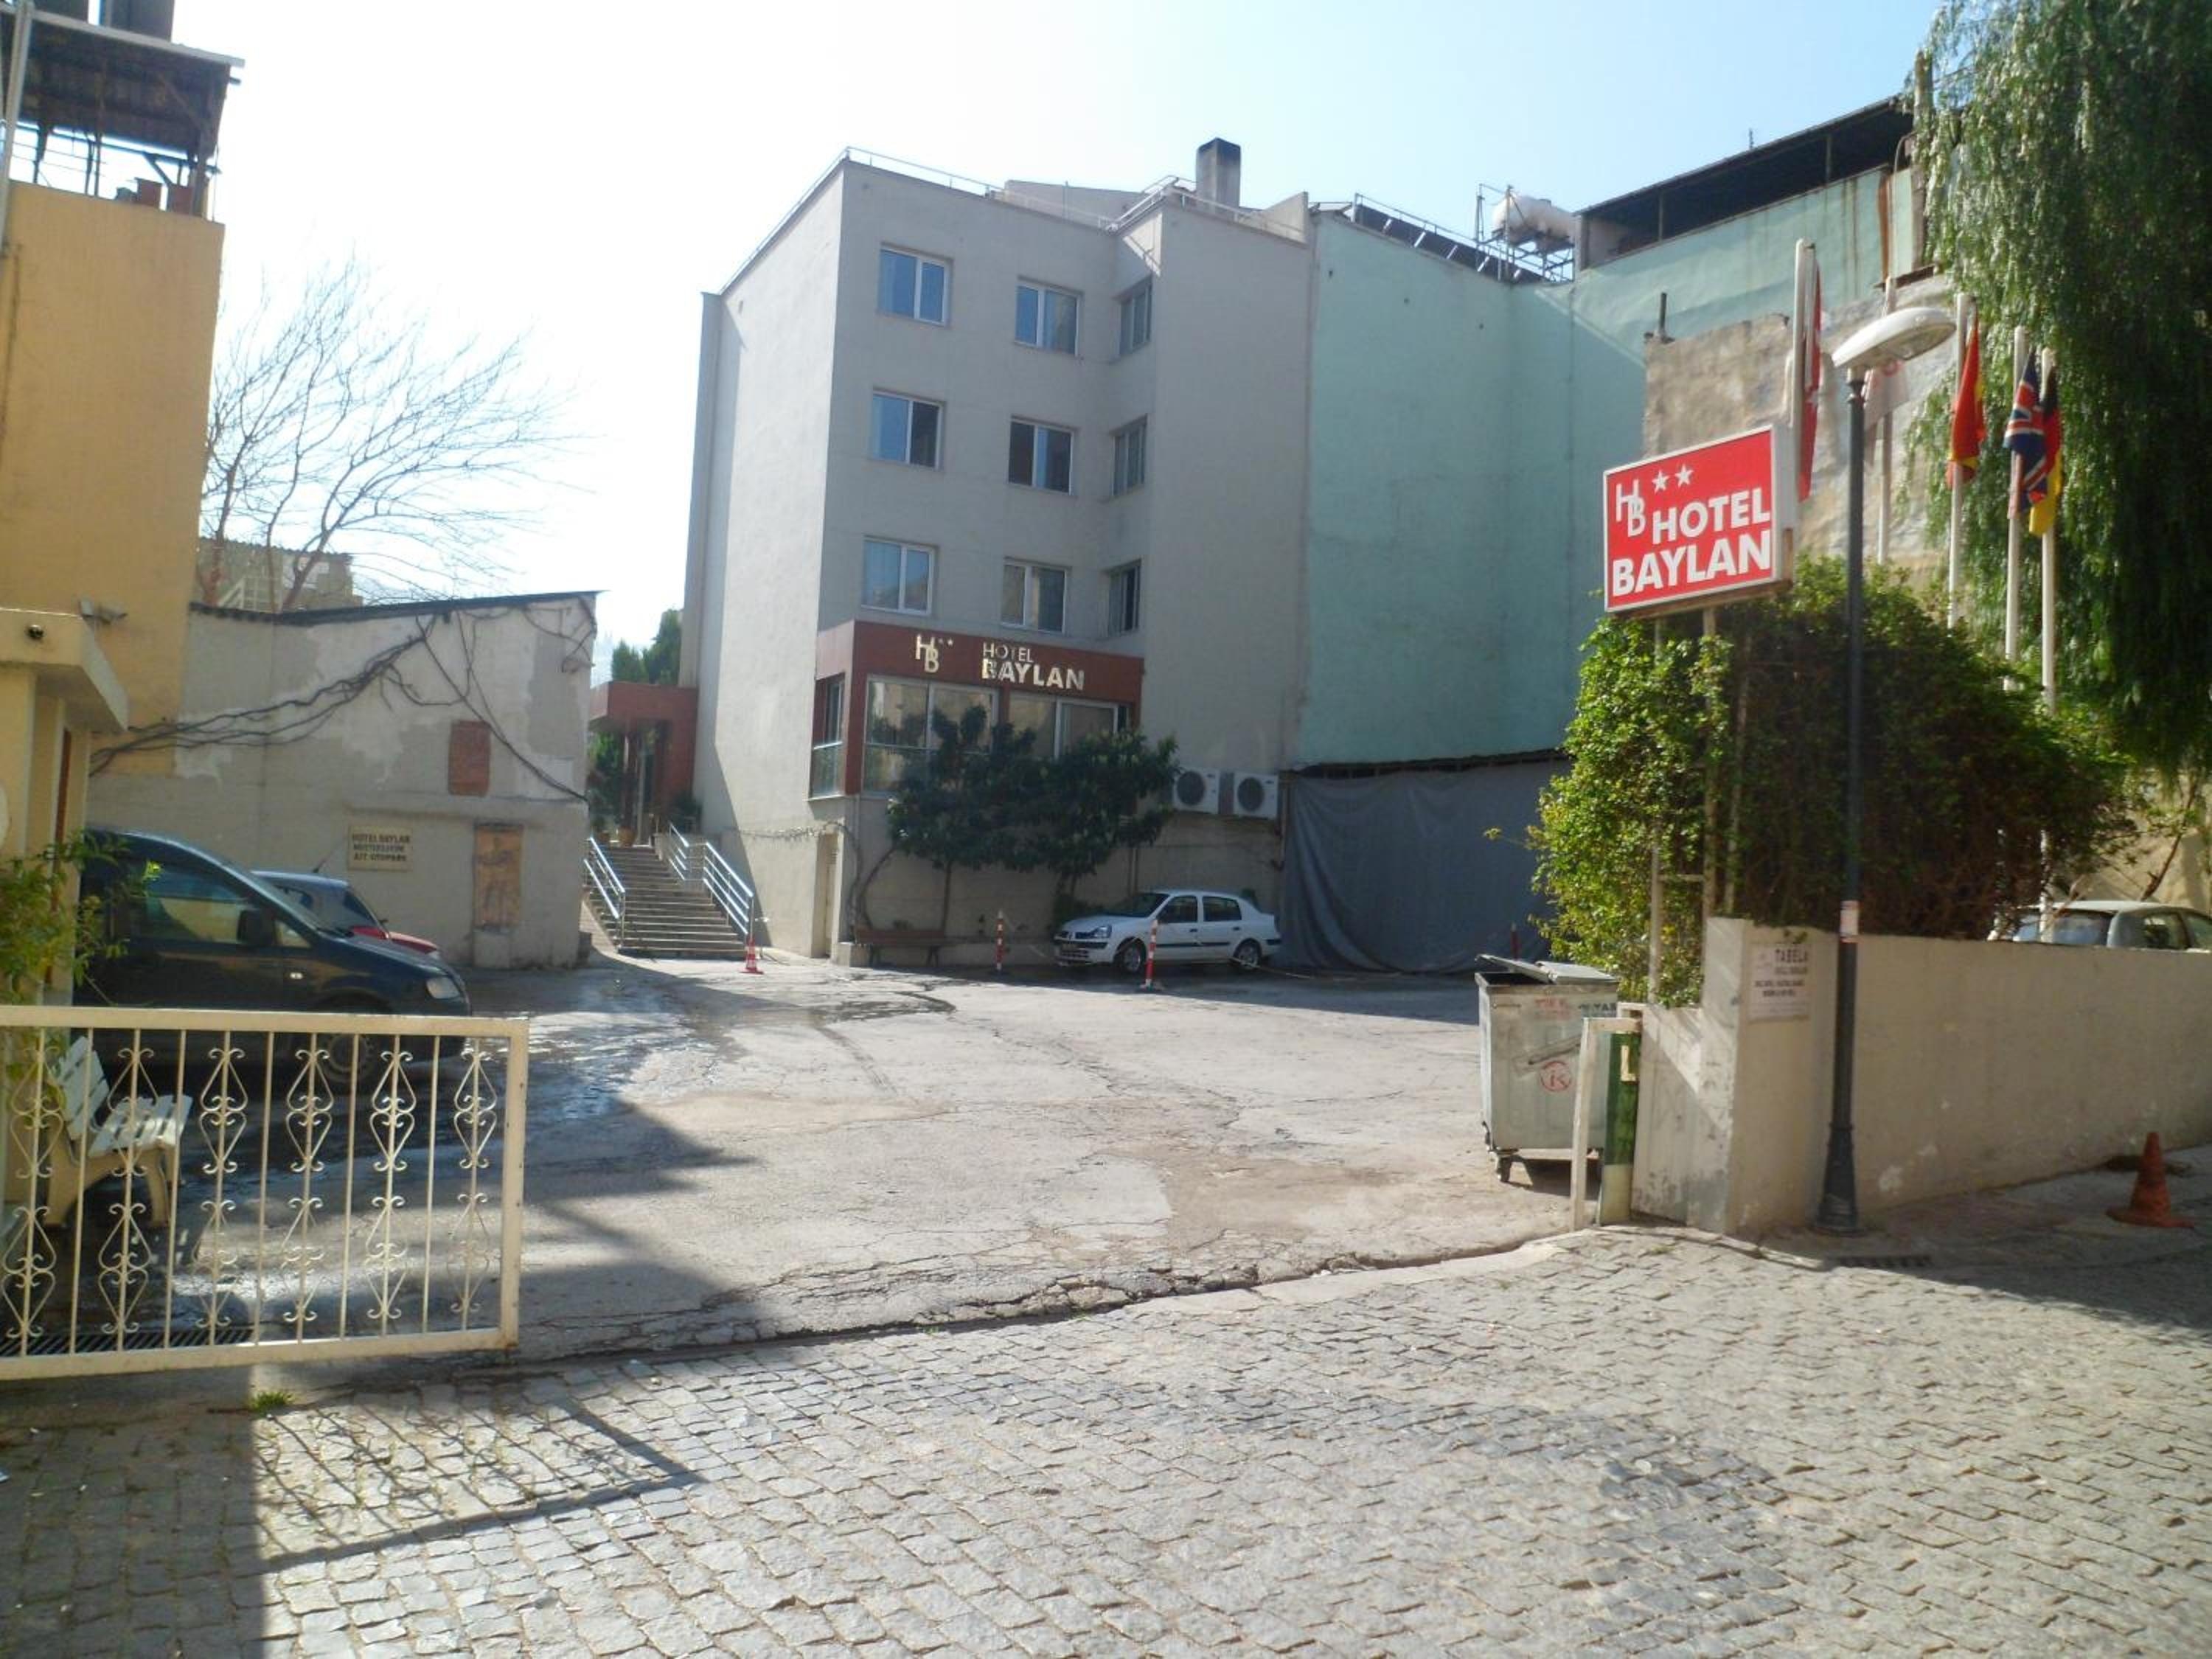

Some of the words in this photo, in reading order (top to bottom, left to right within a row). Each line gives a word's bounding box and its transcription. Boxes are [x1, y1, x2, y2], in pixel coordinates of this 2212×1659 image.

[1652, 487, 1770, 545] HOTEL
[1612, 529, 1771, 597] BAYLAN
[981, 658, 1085, 691] BAYLAN
[982, 641, 1034, 663] HOTEL
